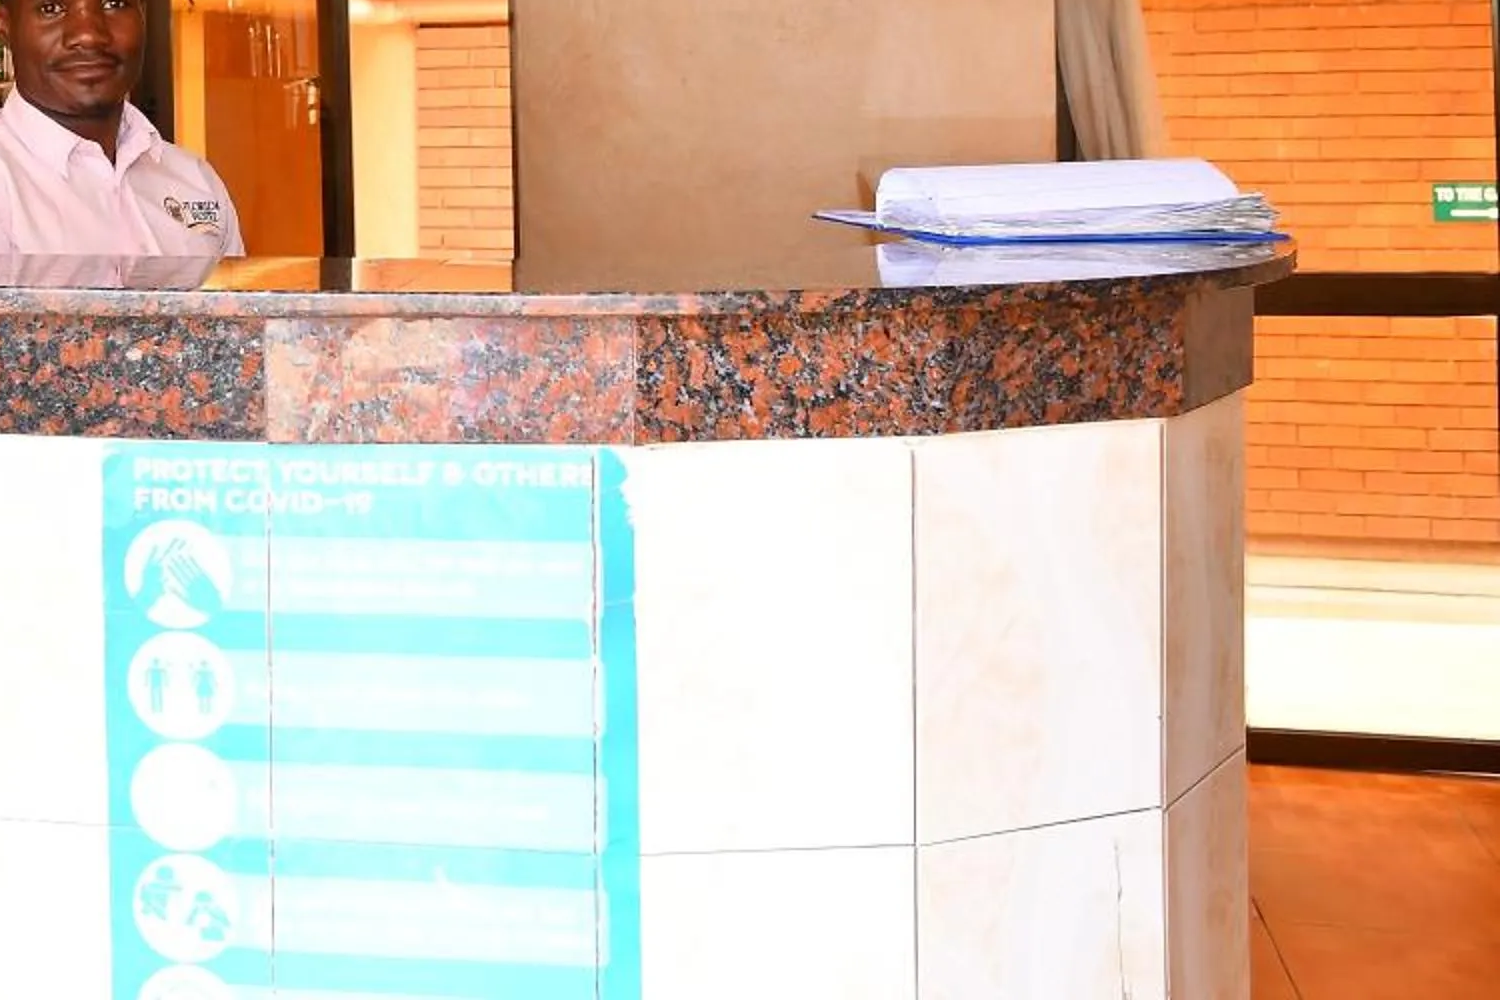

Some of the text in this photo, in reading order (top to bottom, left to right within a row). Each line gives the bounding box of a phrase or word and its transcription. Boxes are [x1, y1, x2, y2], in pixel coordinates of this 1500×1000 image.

[1435, 187, 1454, 202] TO
[1456, 187, 1482, 201] THE
[133, 457, 267, 483] PROTECT
[281, 460, 434, 487] YOURSELF
[134, 486, 374, 514] FROM COVID-19
